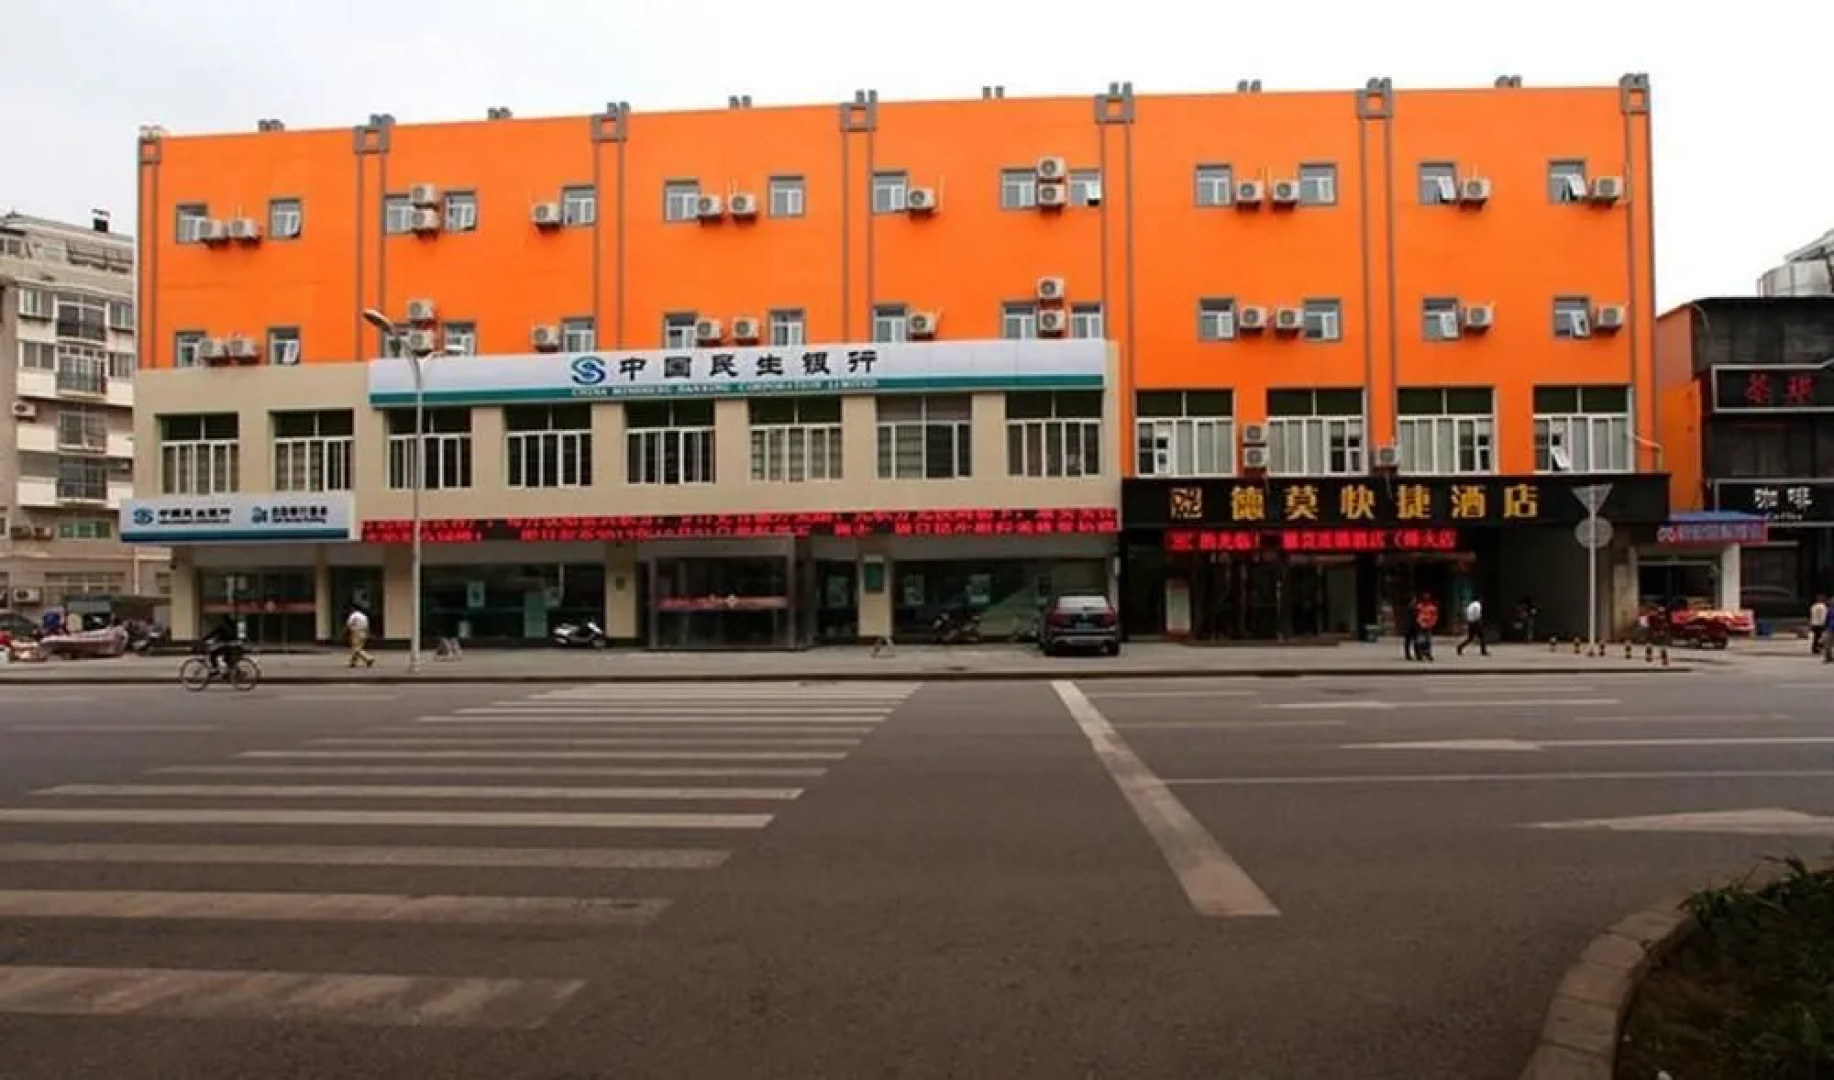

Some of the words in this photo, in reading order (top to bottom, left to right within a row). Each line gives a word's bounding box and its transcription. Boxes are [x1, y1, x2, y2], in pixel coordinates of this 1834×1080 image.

[619, 350, 877, 381] 中国民生银行
[1230, 484, 1538, 520] 德莫快捷酒店
[1755, 487, 1812, 510] 咖啡
